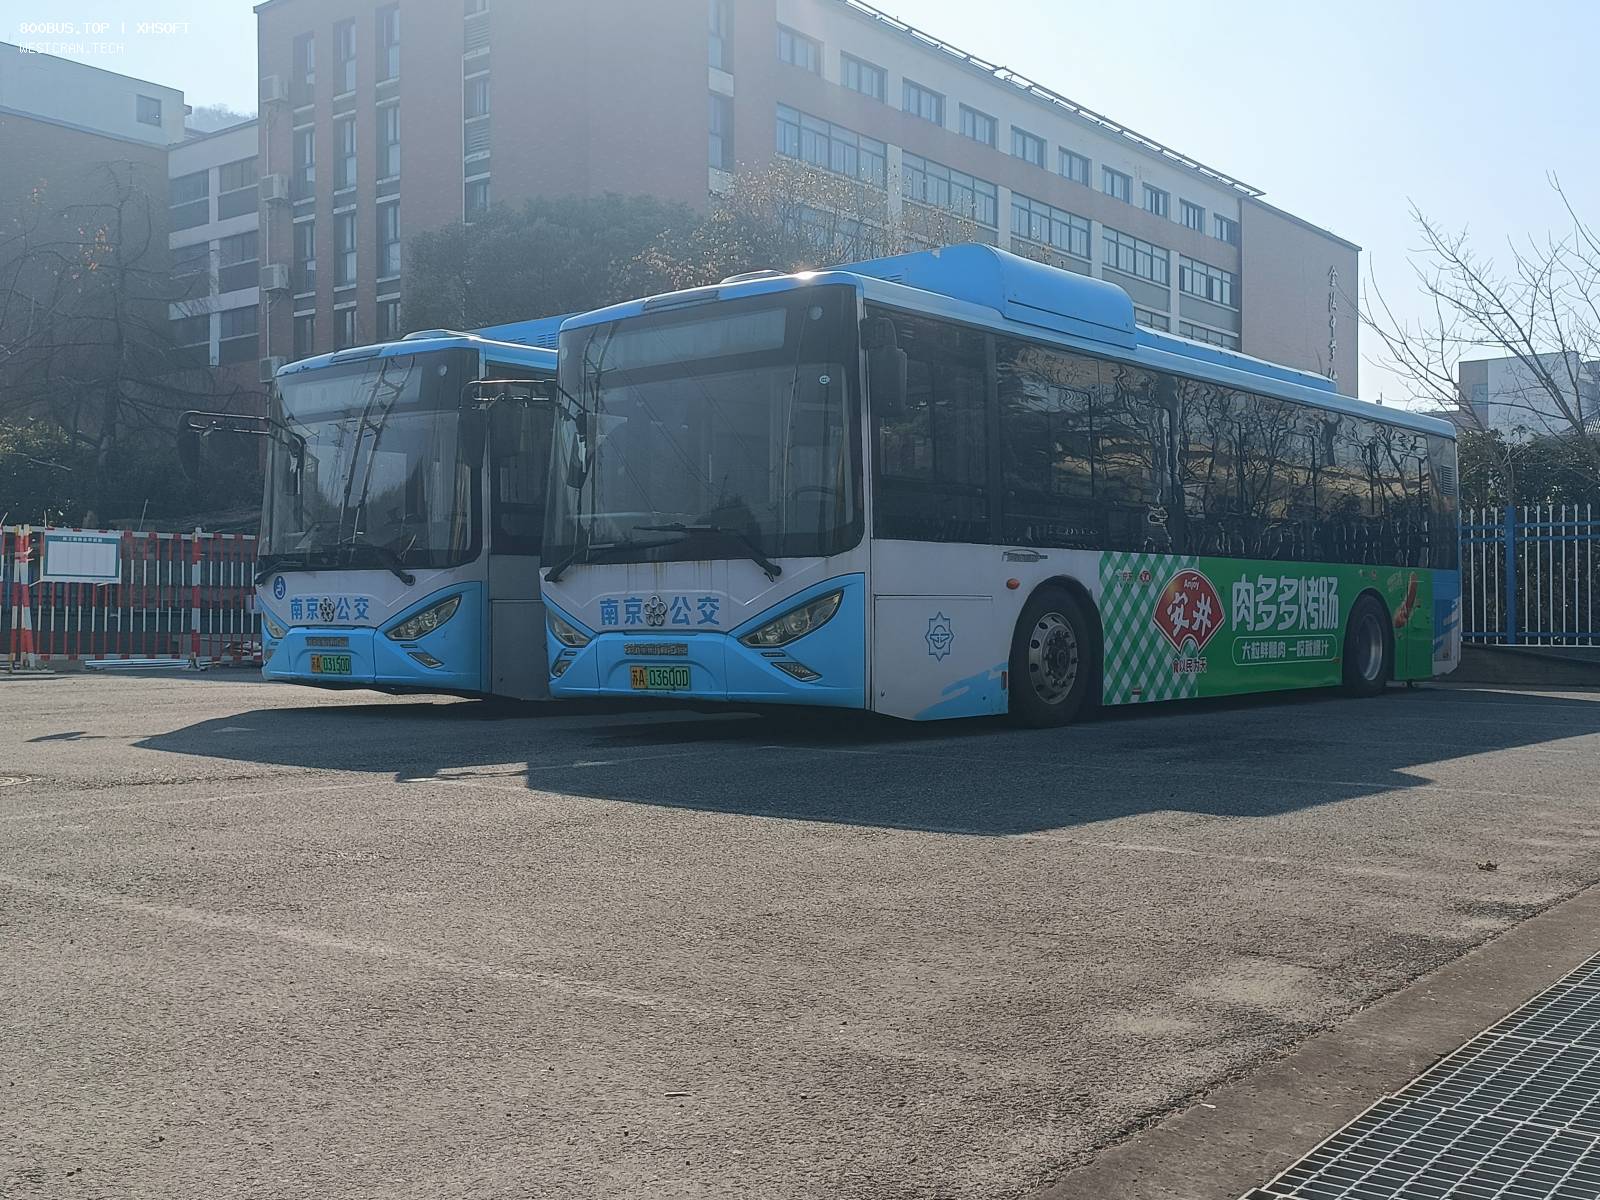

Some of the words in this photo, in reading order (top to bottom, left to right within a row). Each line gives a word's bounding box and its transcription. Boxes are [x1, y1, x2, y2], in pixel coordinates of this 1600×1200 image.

[1184, 577, 1200, 590] Anjoy
[290, 597, 320, 621] 南京
[336, 597, 370, 621] 公交
[599, 597, 644, 626] 南京
[669, 596, 720, 626] 公交
[1167, 591, 1212, 637] 安井
[1231, 573, 1339, 631] 肉多多烤肠
